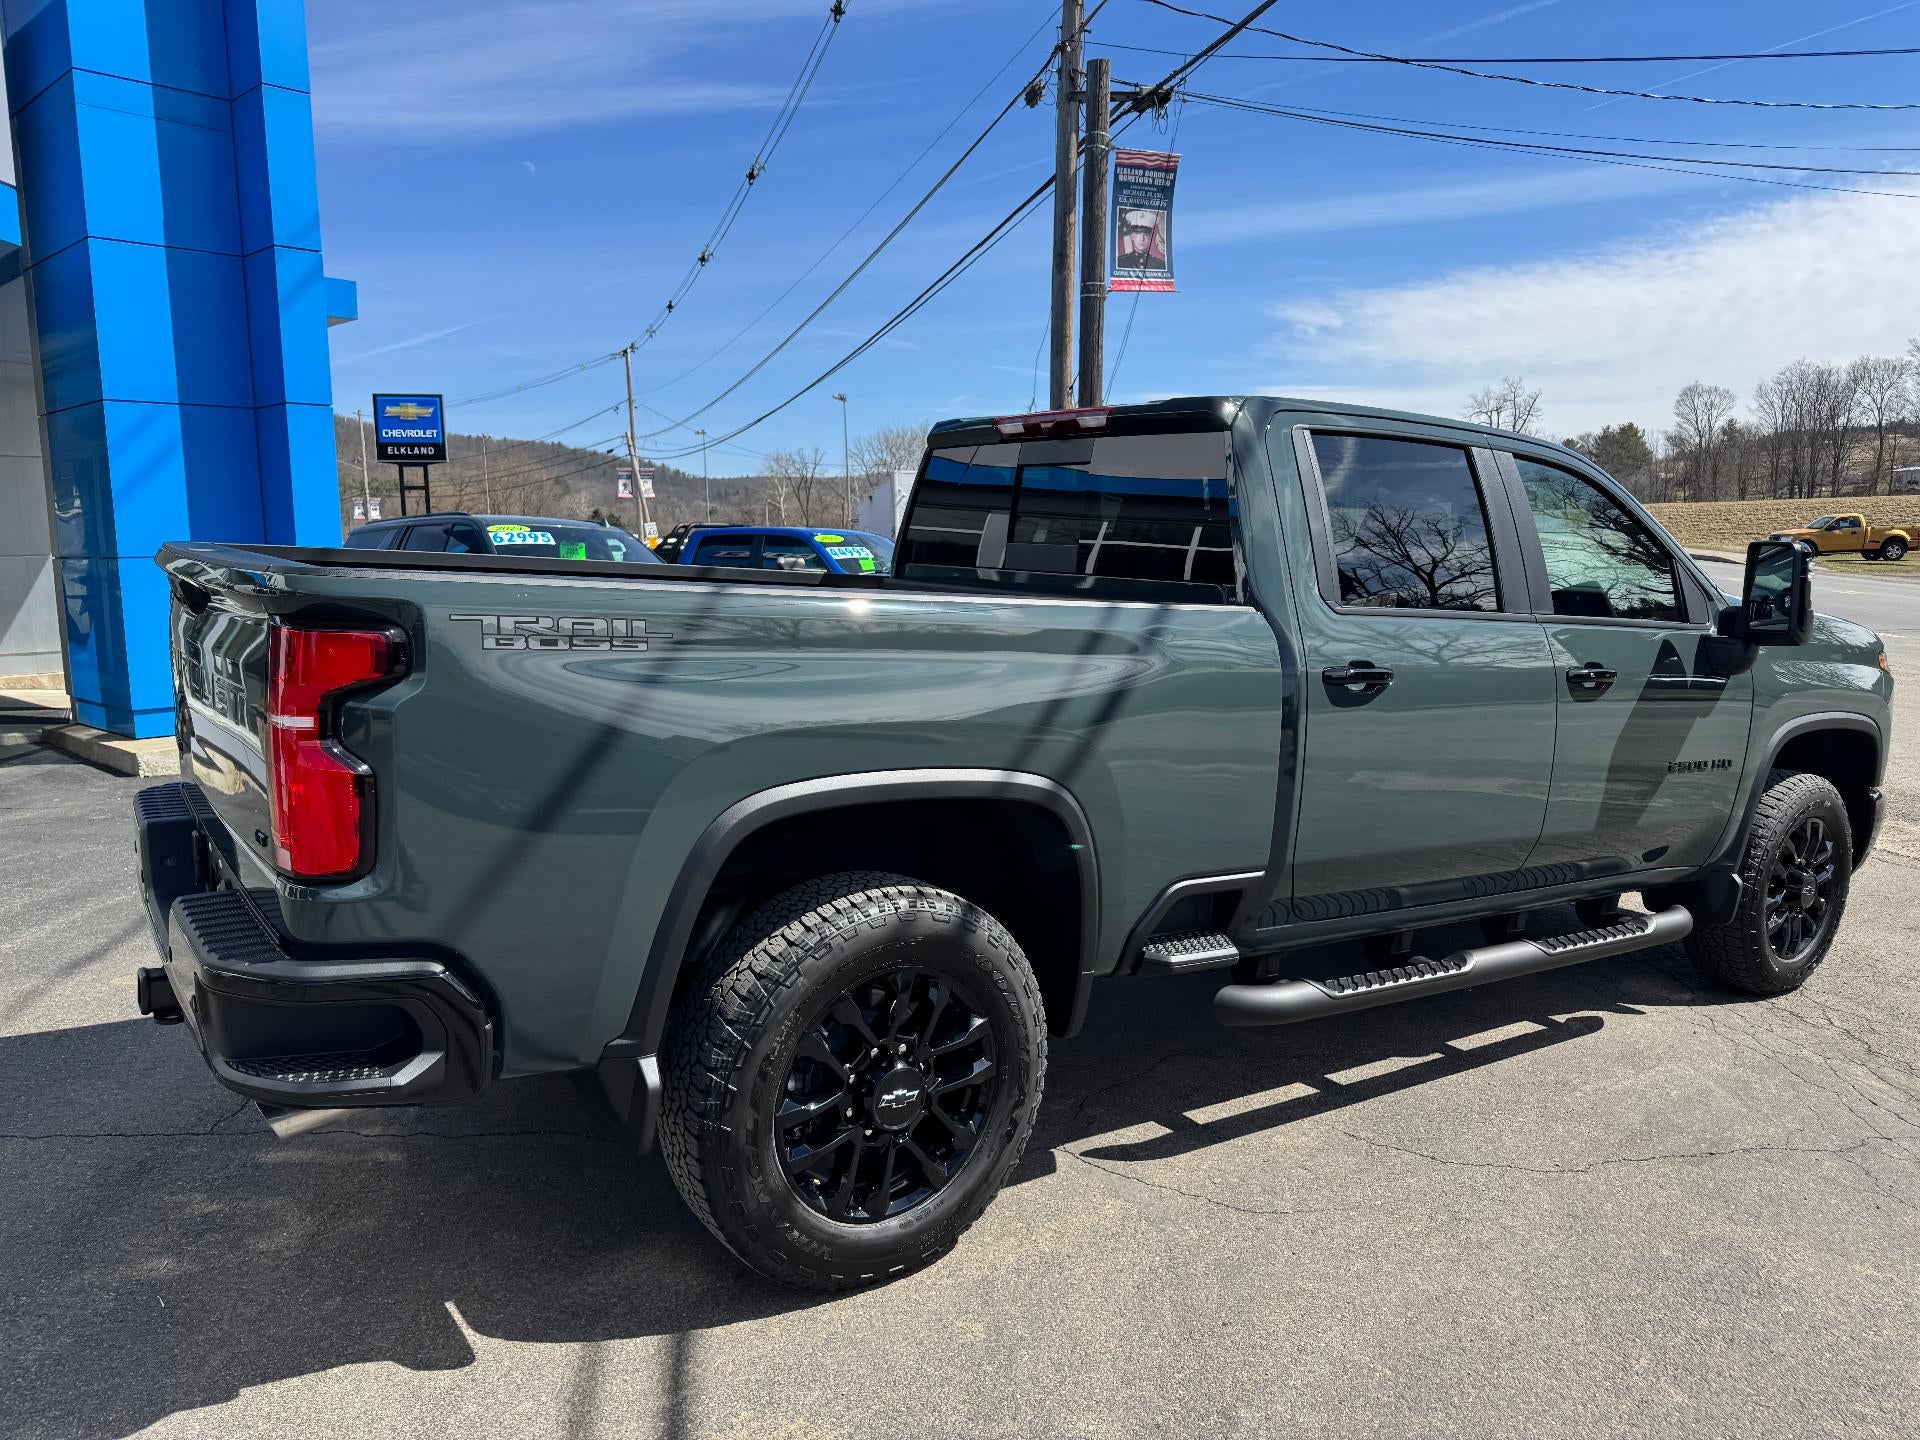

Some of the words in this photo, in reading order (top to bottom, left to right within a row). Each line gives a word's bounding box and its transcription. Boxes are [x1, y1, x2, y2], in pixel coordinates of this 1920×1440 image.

[1119, 174, 1153, 184] HOMETOWN
[382, 429, 438, 438] CHEVROLET
[388, 446, 435, 455] ELKLAND
[492, 532, 551, 544] 62995
[829, 547, 870, 557] 44995
[449, 613, 674, 638] TRAIL
[482, 633, 649, 651] BOSS
[1711, 758, 1733, 769] HD
